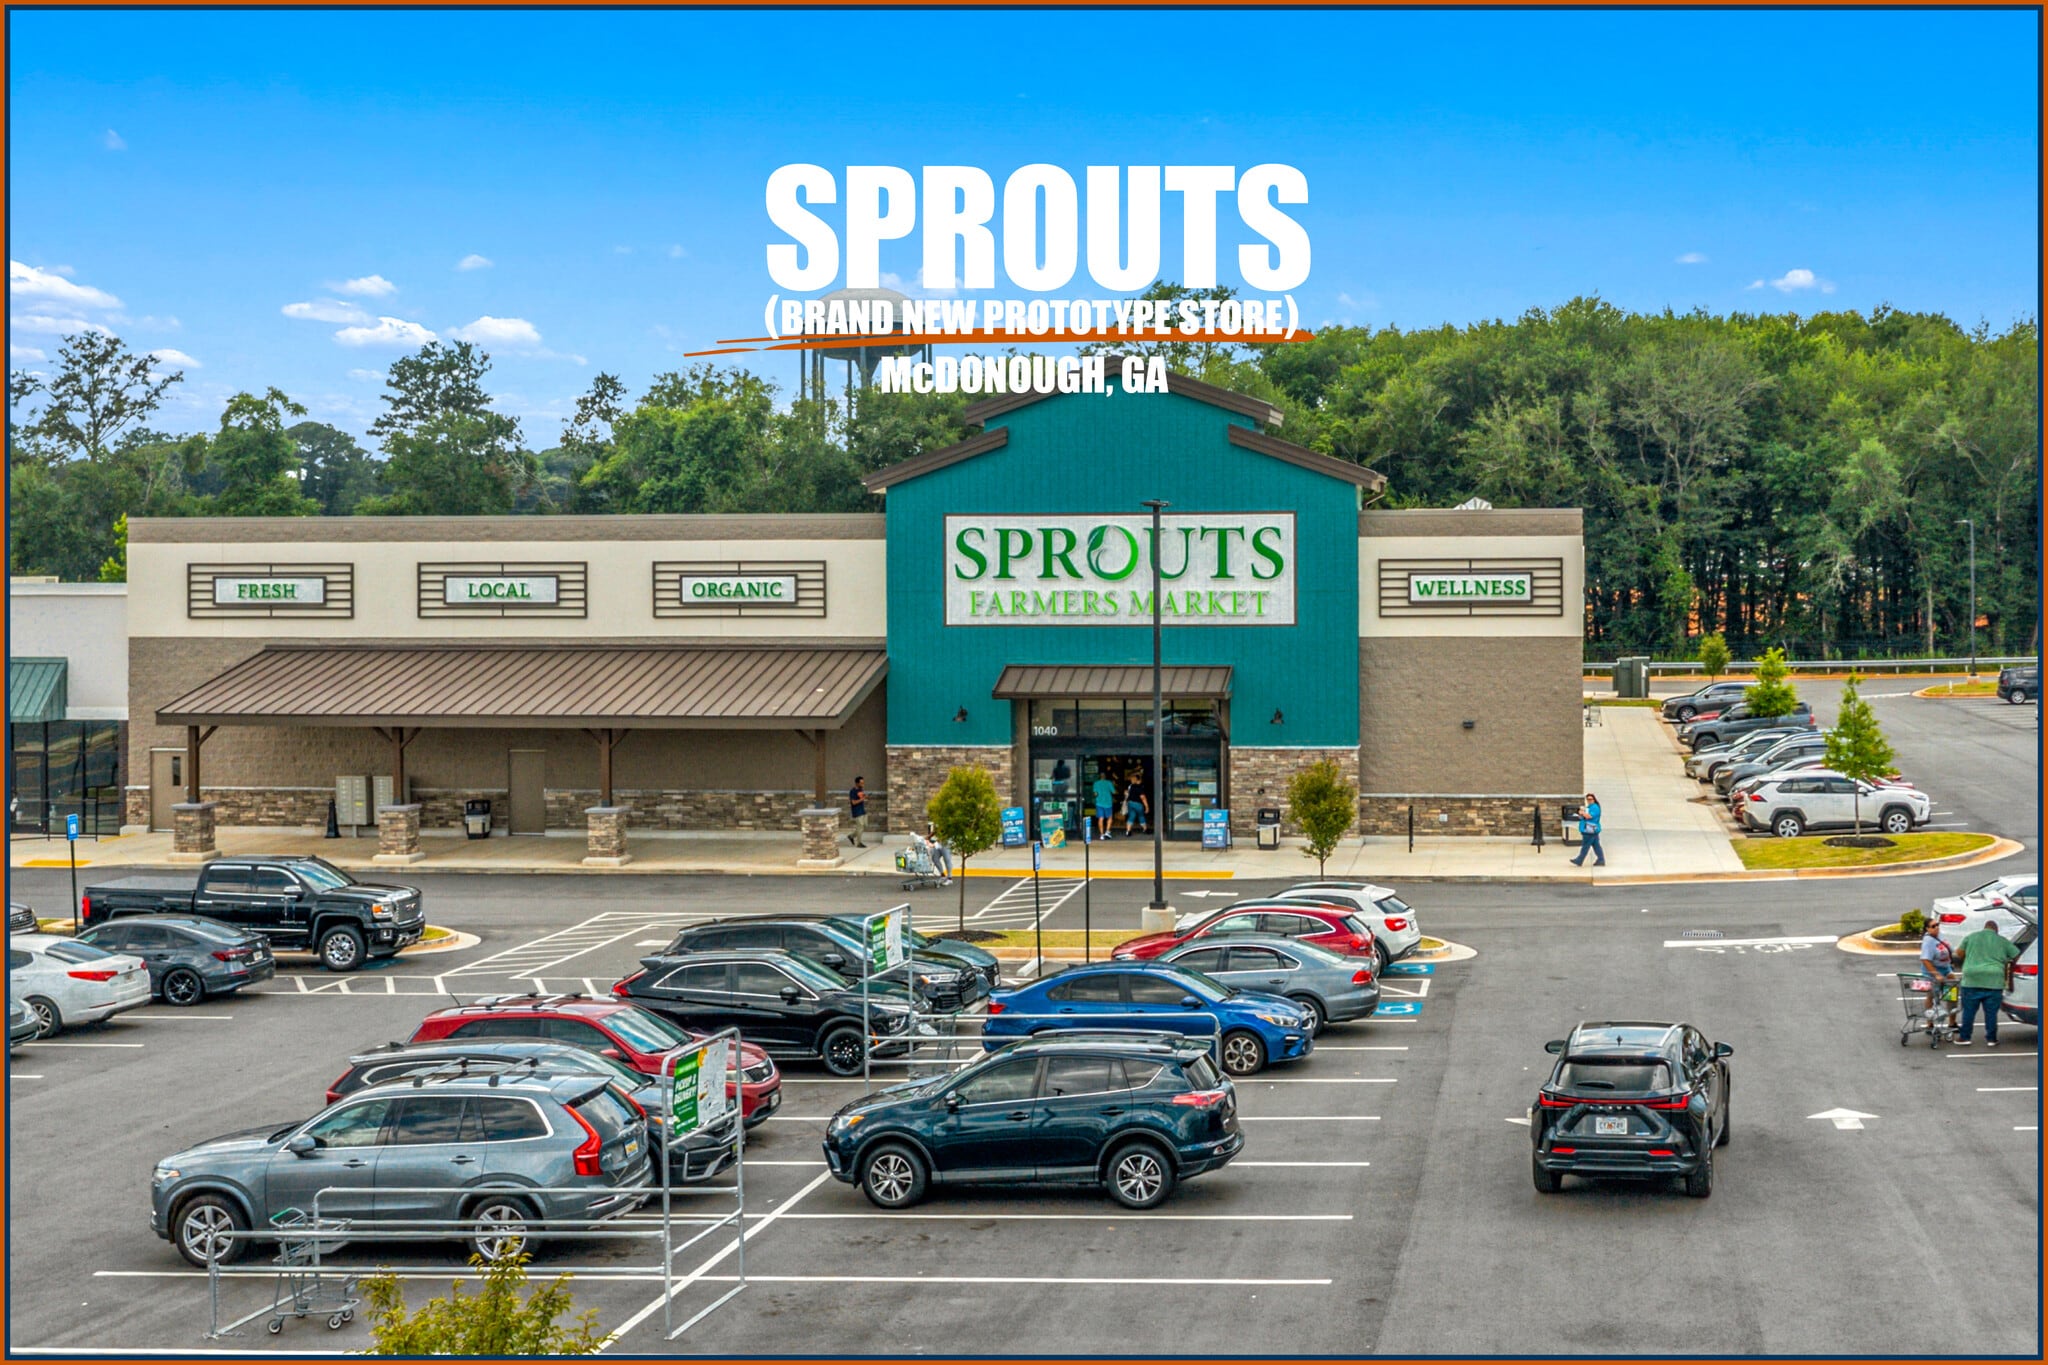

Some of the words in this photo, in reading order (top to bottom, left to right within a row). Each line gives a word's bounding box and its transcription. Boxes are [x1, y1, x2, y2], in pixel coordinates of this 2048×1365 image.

[954, 525, 1285, 582] SPROUTS
[237, 583, 297, 599] FRESH
[468, 583, 530, 598] LOCAL
[692, 582, 782, 598] ORGANIC
[1415, 580, 1526, 596] WELLNESS
[969, 590, 1119, 617] FARMERS
[1129, 590, 1270, 616] MARKET
[1034, 726, 1058, 737] 1040
